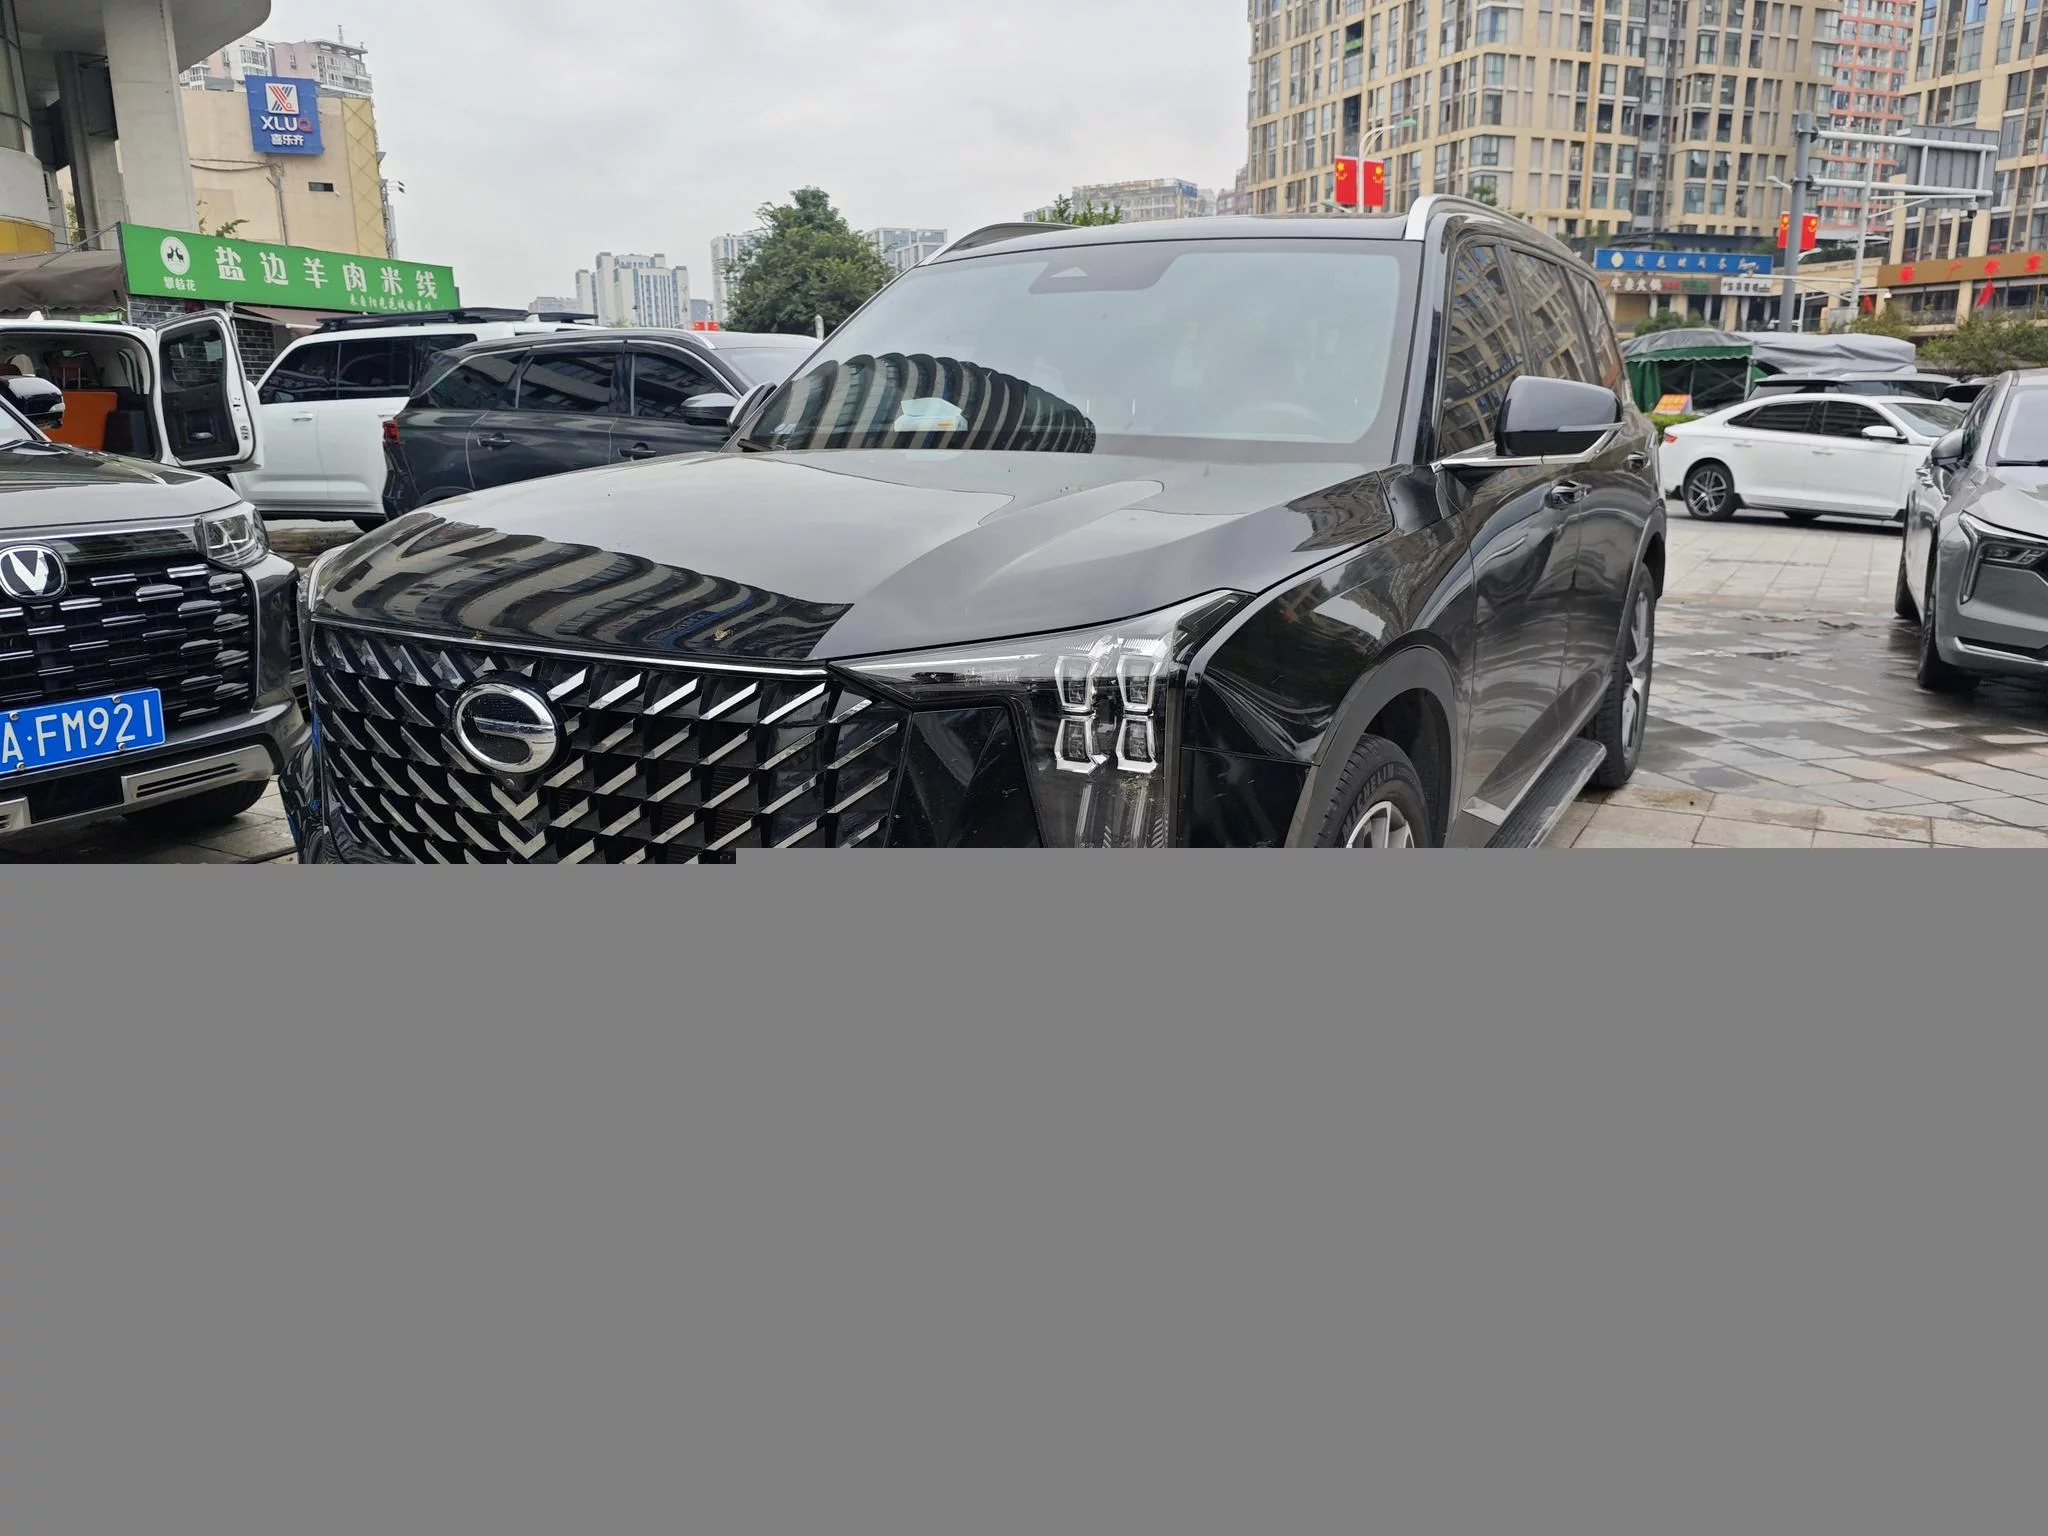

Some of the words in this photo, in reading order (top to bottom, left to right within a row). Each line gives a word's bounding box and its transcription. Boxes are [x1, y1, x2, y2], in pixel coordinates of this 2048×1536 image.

[260, 116, 312, 132] XLUQ
[271, 133, 304, 146] 喜乐齐
[215, 246, 437, 299] 盐边羊肉米线
